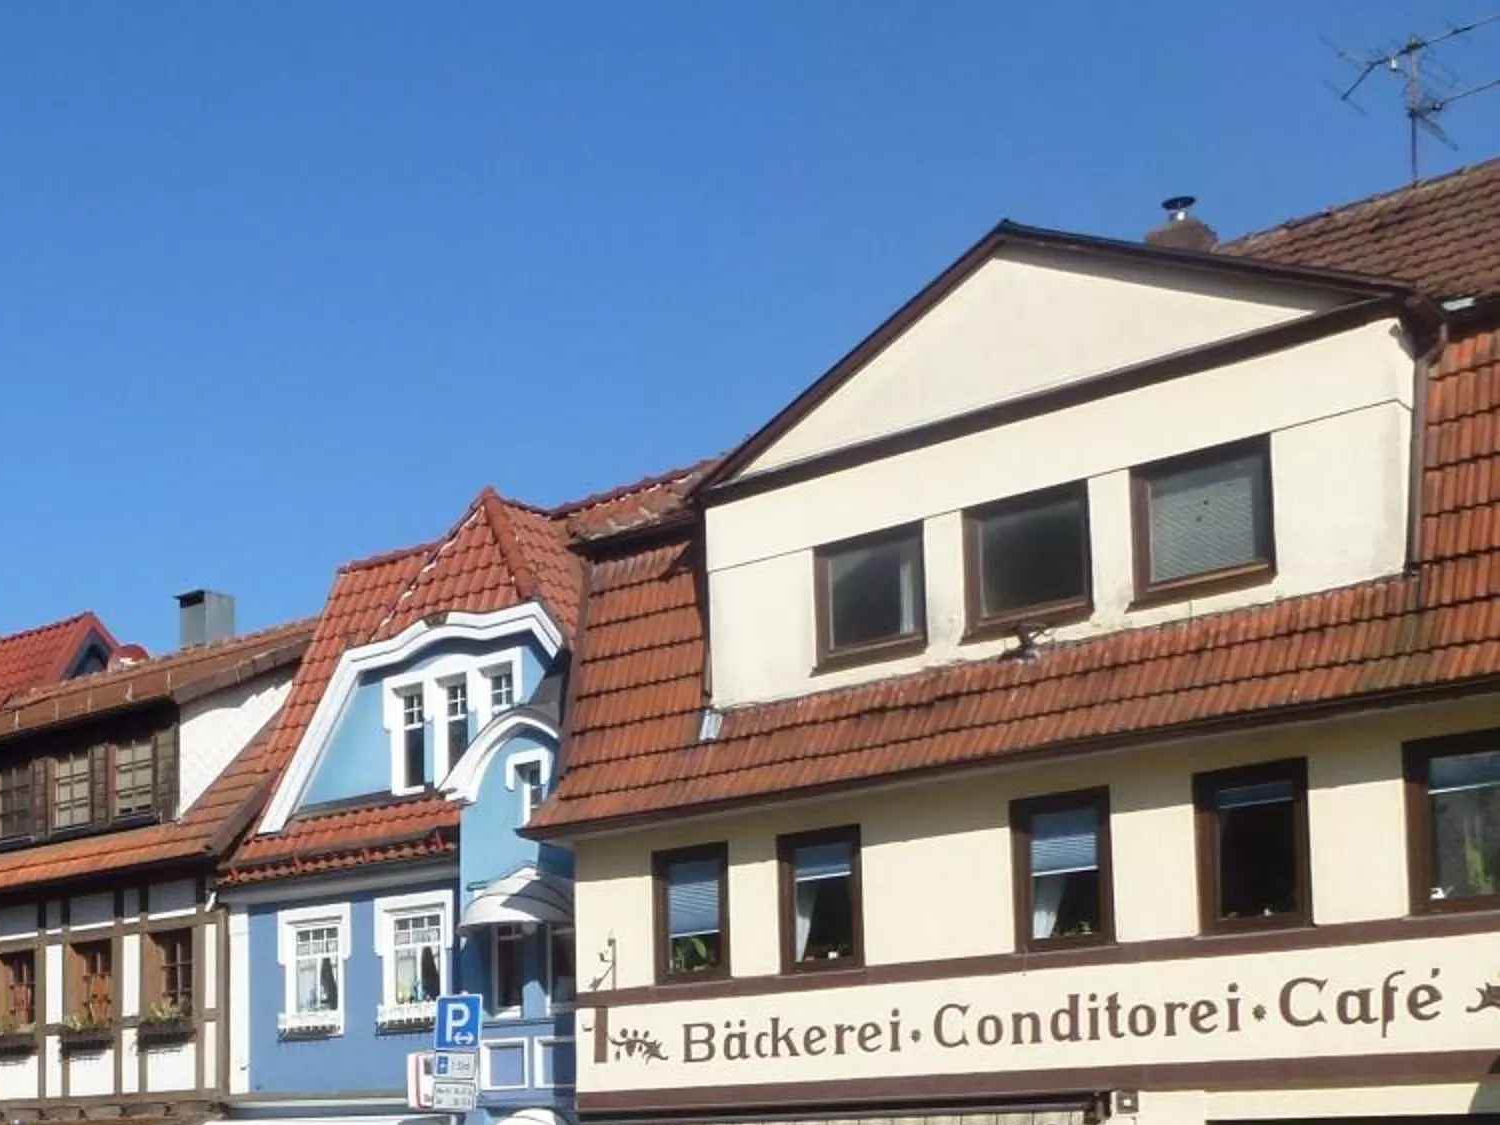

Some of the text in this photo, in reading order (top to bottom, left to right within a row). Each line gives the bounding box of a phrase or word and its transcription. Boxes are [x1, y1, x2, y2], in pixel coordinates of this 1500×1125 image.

[445, 1003, 470, 1042] P
[682, 967, 1444, 1063] Bäckerei Conditorei Café
